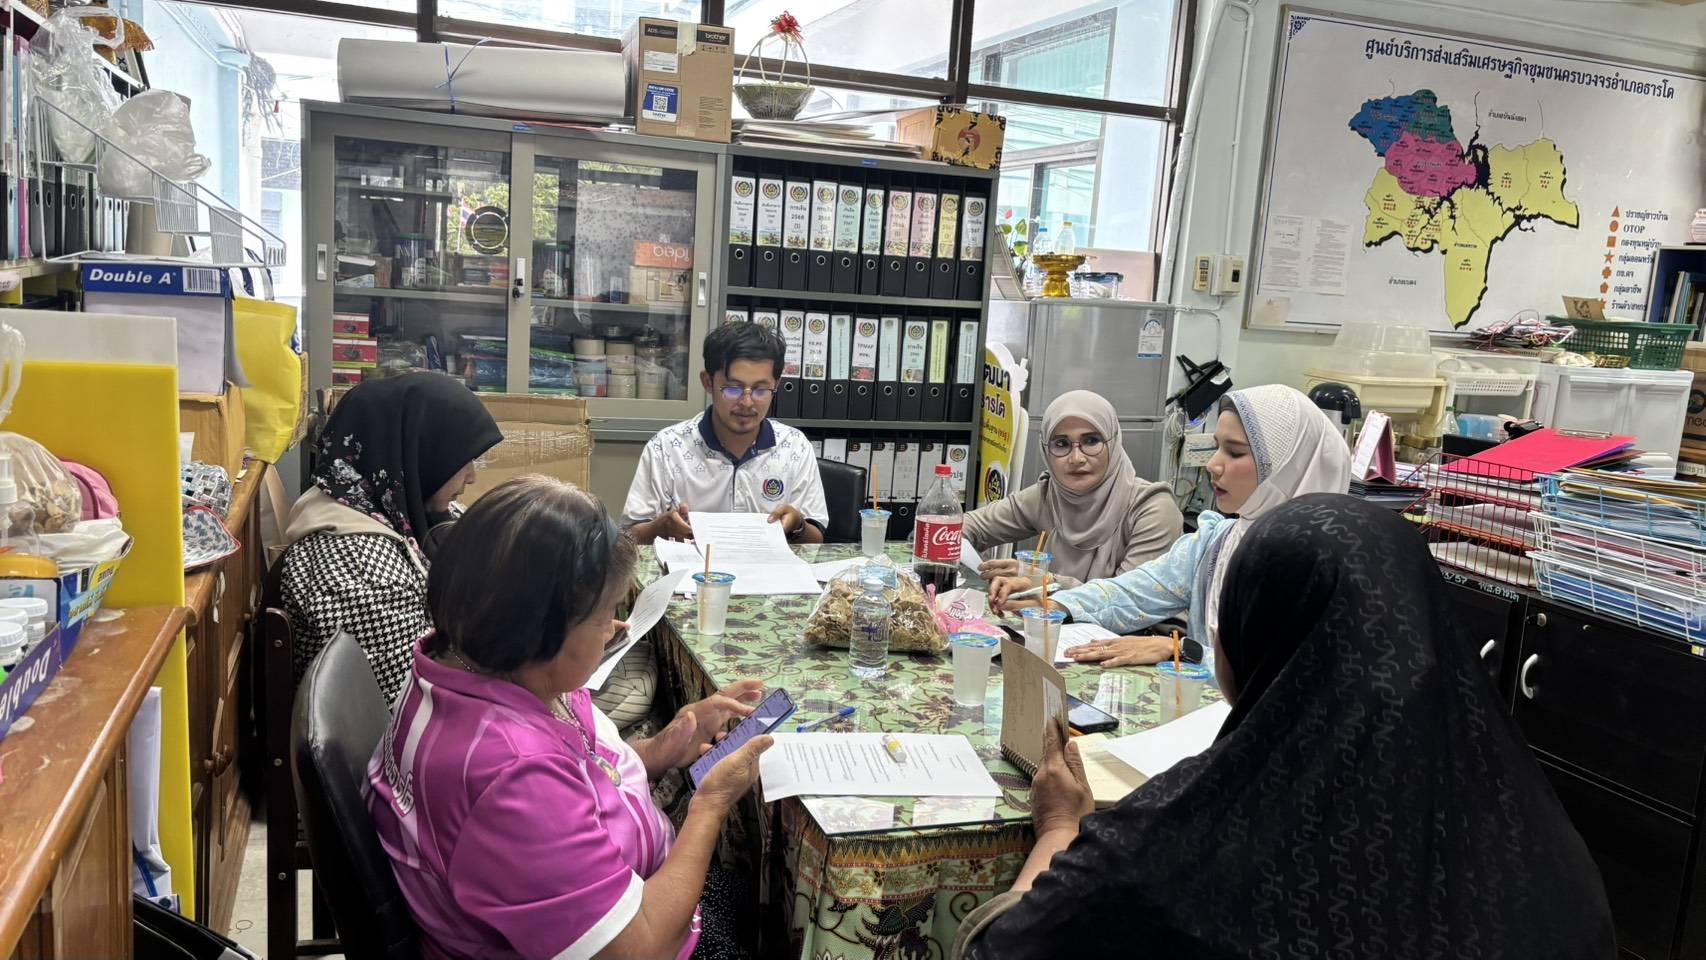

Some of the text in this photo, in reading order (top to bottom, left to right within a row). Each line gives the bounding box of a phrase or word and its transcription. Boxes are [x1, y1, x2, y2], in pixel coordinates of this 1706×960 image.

[705, 32, 727, 41] brother
[1623, 224, 1645, 233] OTOP
[89, 268, 171, 285] Double A
